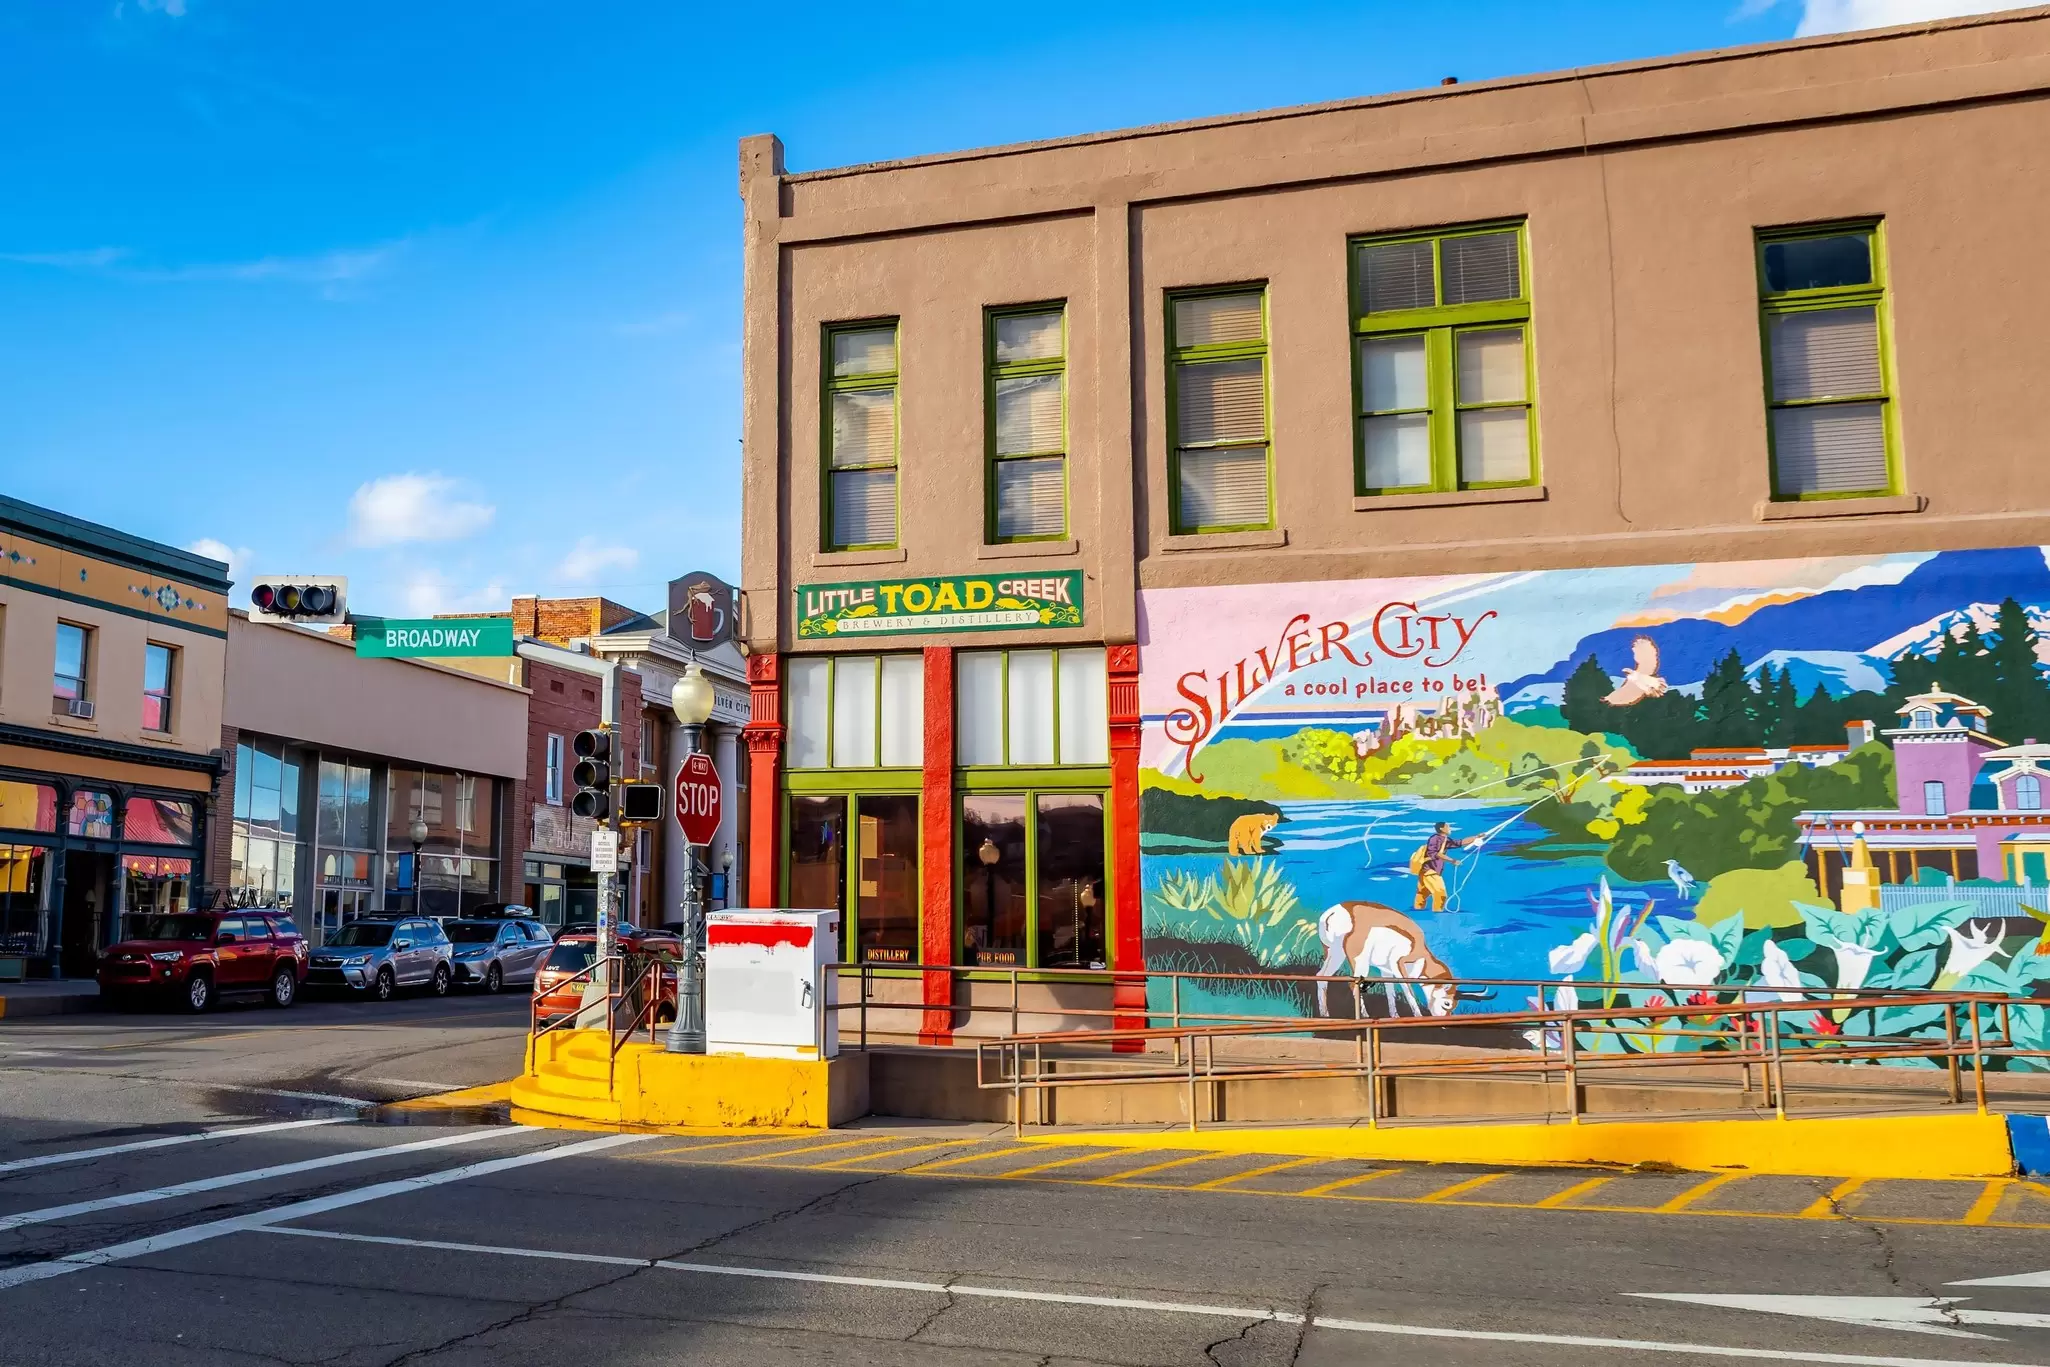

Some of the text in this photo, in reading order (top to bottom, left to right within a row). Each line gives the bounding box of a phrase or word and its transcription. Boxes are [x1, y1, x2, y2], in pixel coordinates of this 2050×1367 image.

[807, 577, 1071, 617] LITTLE TOAD CREEK
[842, 611, 1033, 630] BREWERY & DISTILLERY
[386, 629, 482, 648] BROADWAY
[1164, 602, 1498, 784] SILVER CITY
[1284, 673, 1487, 699] a cool place to be!
[714, 695, 733, 709] ILVER
[693, 761, 707, 771] 4-WAY
[679, 781, 719, 817] STOP
[867, 949, 910, 961] DISTILLERY
[976, 952, 1015, 964] PUB FOOD
